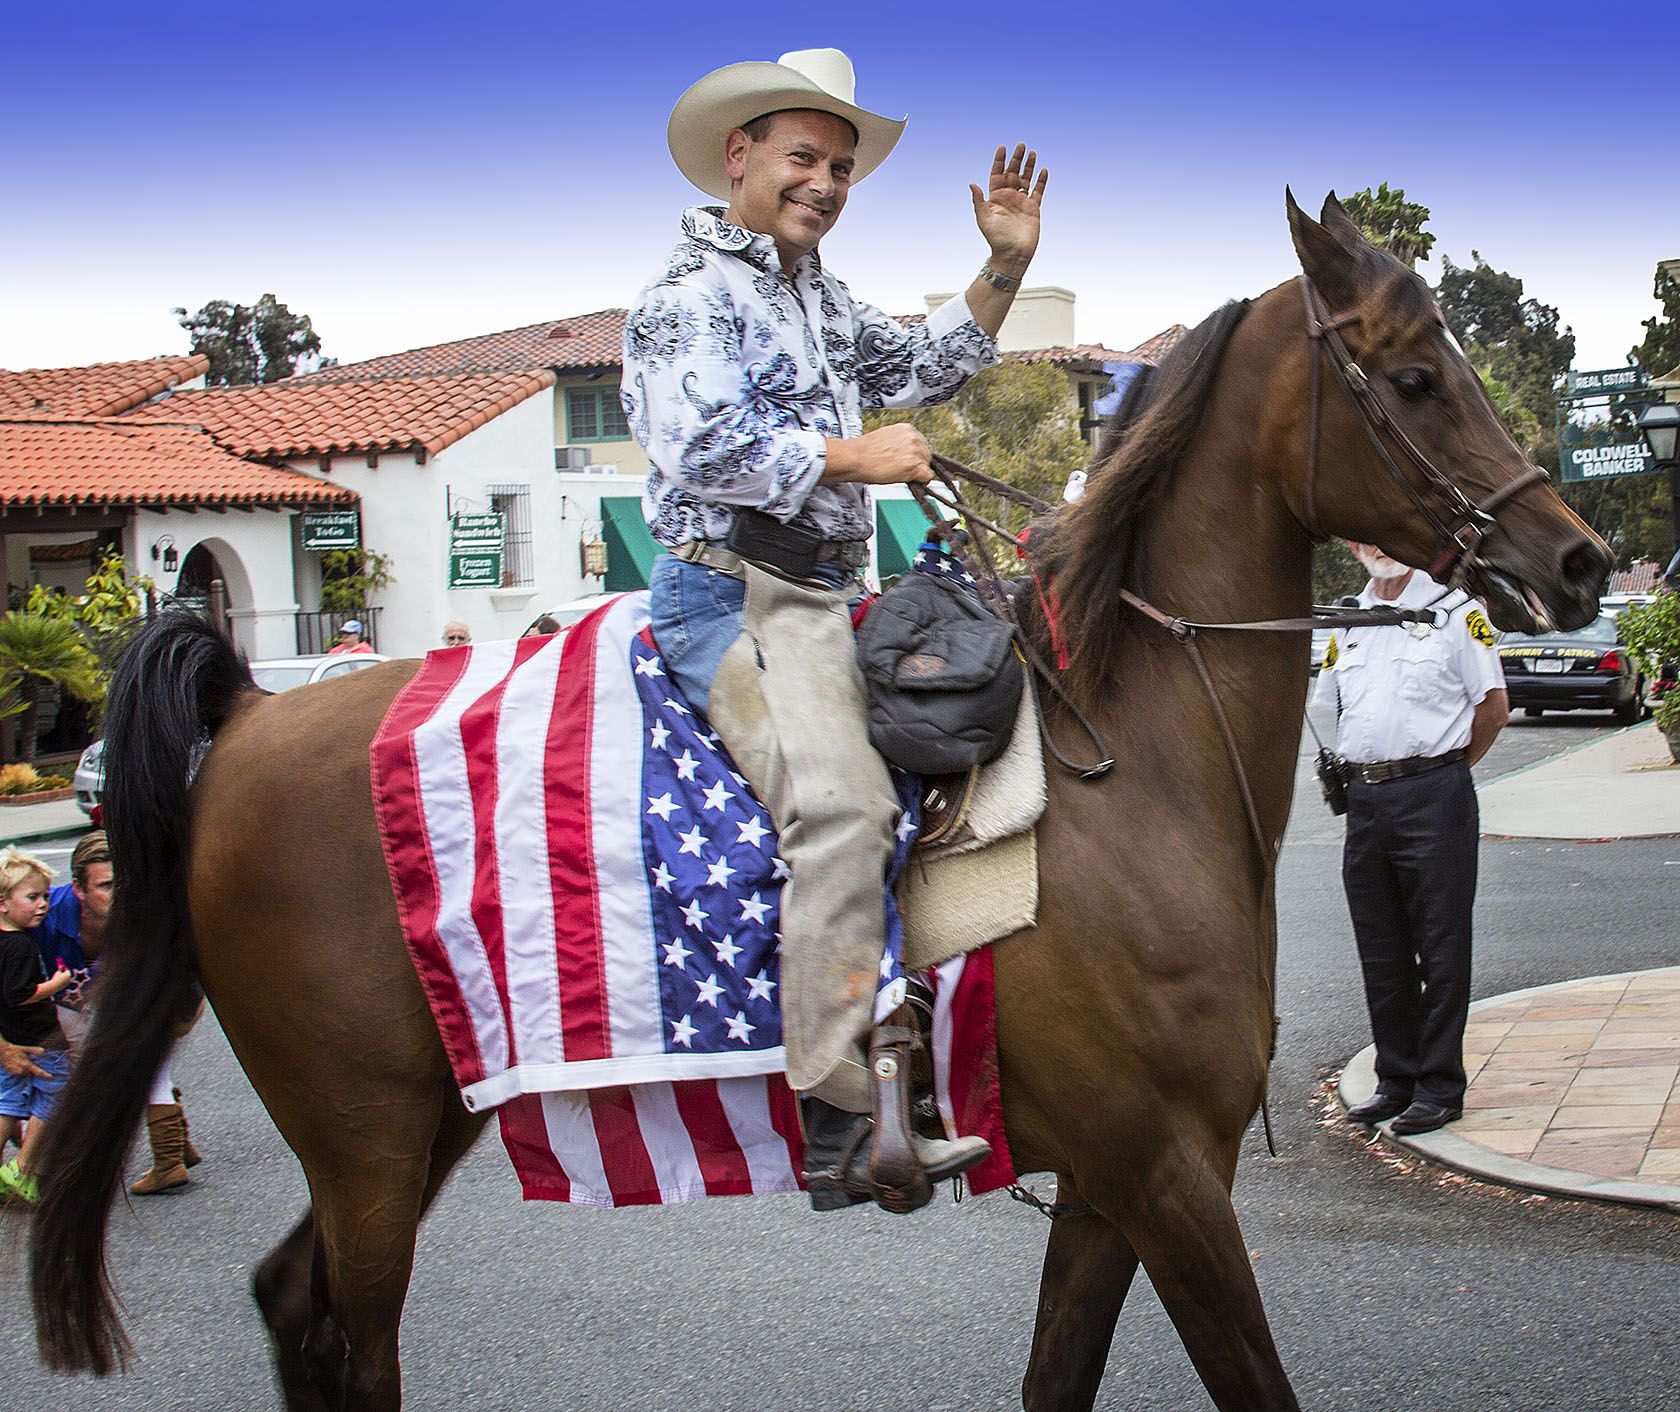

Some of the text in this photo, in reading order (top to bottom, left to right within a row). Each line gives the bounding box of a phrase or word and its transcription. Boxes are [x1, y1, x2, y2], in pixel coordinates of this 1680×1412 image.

[1576, 371, 1636, 388] REAL ESTATE
[1572, 443, 1652, 464] COLDWELL
[1583, 458, 1645, 477] BANKER
[459, 557, 492, 568] Frozen
[459, 567, 491, 579] Yogurt
[1557, 648, 1597, 658] PATROL
